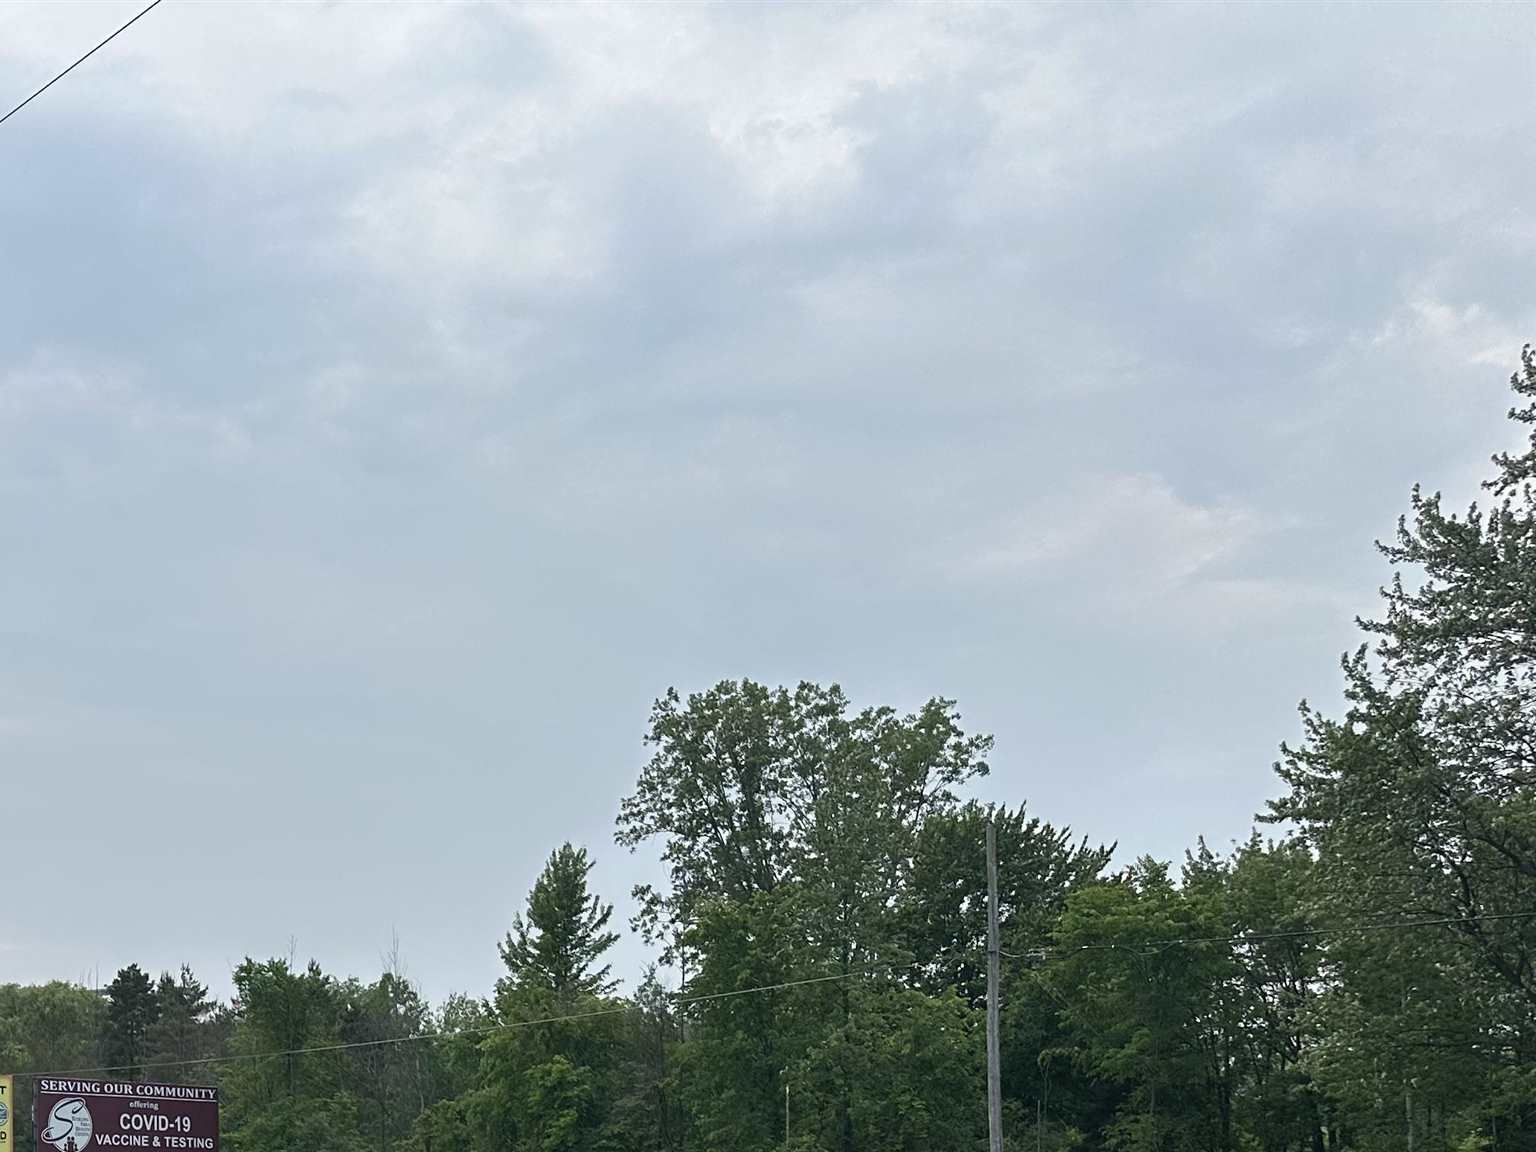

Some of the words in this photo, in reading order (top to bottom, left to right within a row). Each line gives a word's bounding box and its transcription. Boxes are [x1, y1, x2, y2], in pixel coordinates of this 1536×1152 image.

[41, 1080, 101, 1093] SERVING
[104, 1083, 133, 1095] OUR
[136, 1085, 216, 1099] COMMUNITY
[129, 1100, 159, 1110] offering
[120, 1113, 191, 1132] COVID-19
[95, 1134, 149, 1147] VACCINE
[152, 1136, 161, 1147] &
[164, 1137, 214, 1149] TESTING
